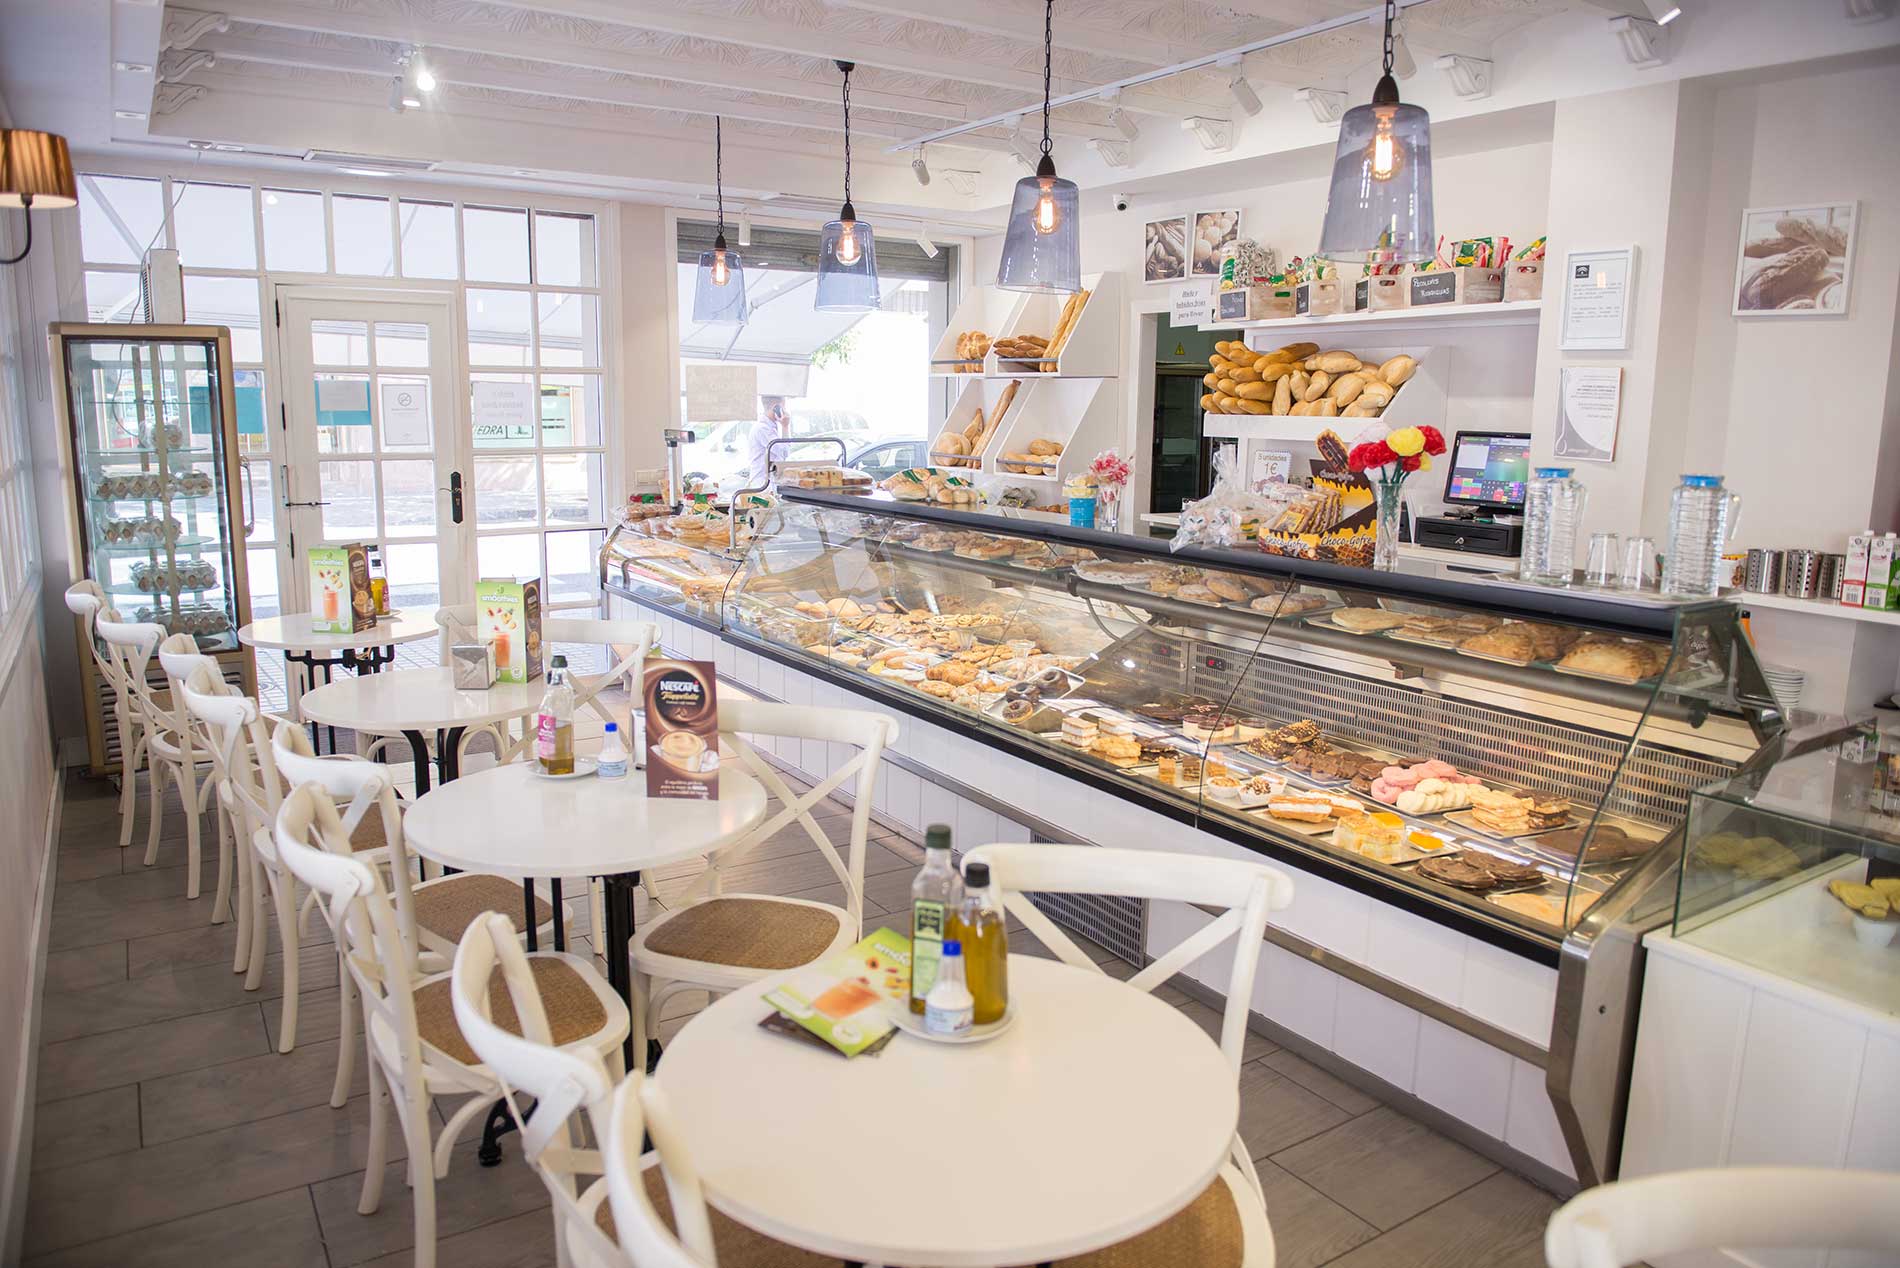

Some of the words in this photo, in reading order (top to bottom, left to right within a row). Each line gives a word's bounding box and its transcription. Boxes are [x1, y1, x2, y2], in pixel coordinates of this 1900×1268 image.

[475, 425, 504, 435] EDRA
[1264, 462, 1279, 475] 1€
[1320, 533, 1373, 548] Choco-Gofre
